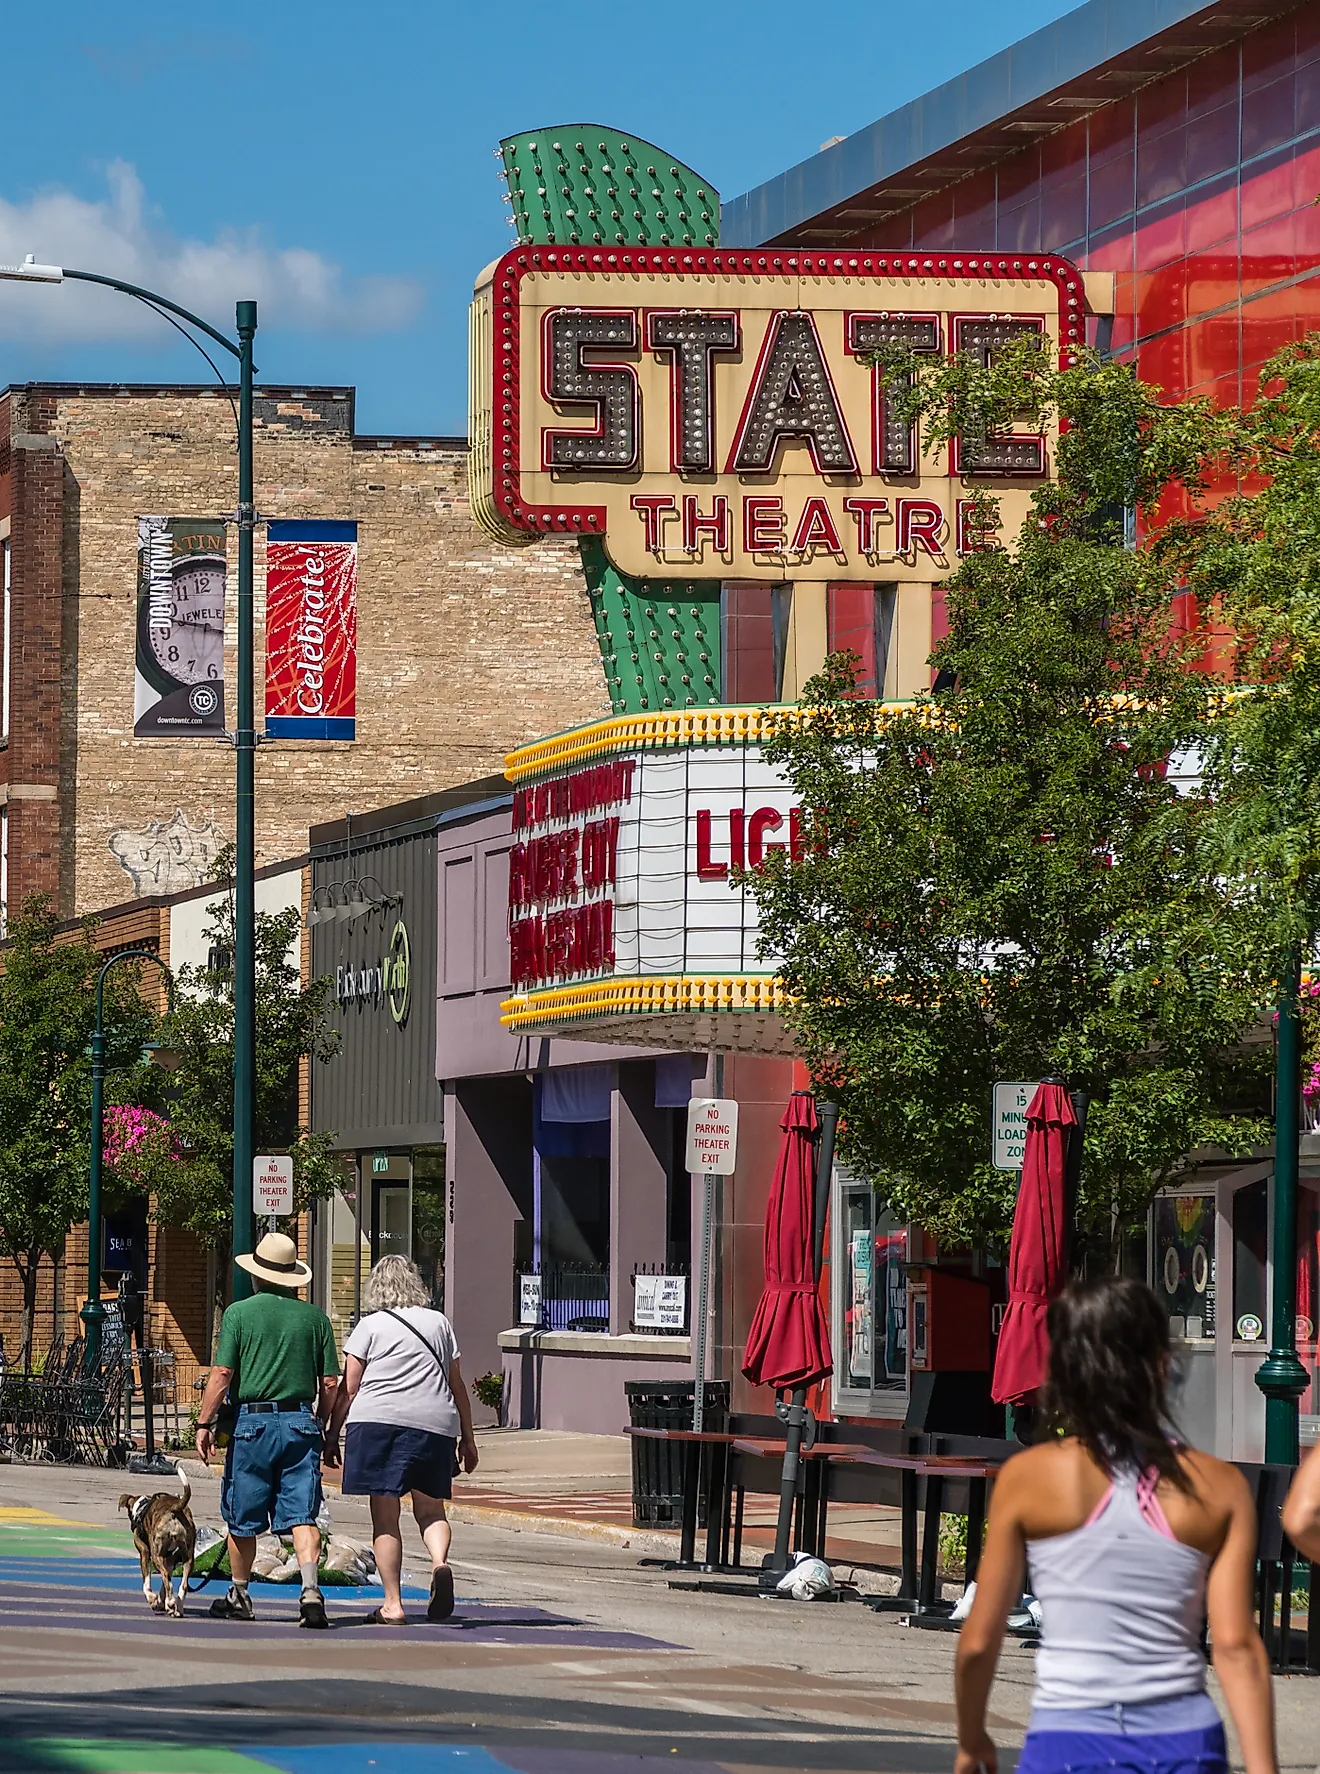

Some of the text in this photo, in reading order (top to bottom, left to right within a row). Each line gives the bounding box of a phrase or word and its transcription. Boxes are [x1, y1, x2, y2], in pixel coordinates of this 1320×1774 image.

[540, 307, 1047, 477] STATE
[629, 494, 1001, 555] THEATRE
[149, 532, 173, 628] DOWNTOWN
[194, 578, 211, 594] 12
[175, 585, 189, 601] 11
[159, 626, 171, 641] 9
[297, 546, 325, 714] Celebrate!
[167, 645, 180, 662] 8
[187, 659, 196, 673] 7
[207, 663, 218, 679] 6
[197, 695, 210, 706] TC
[156, 716, 203, 725] downtowntc.com
[582, 816, 621, 889] CITY
[1016, 1095, 1027, 1106] 15
[707, 1110, 719, 1119] NO
[1001, 1112, 1028, 1123] MINU
[695, 1123, 730, 1134] PARKING
[997, 1129, 1027, 1140] LOAD
[694, 1138, 730, 1149] THEATER
[701, 1153, 720, 1163] EXIT
[268, 1164, 278, 1173] NO
[259, 1175, 287, 1184] PARKING
[259, 1187, 287, 1195] THEATER
[266, 1199, 280, 1207] EXIT
